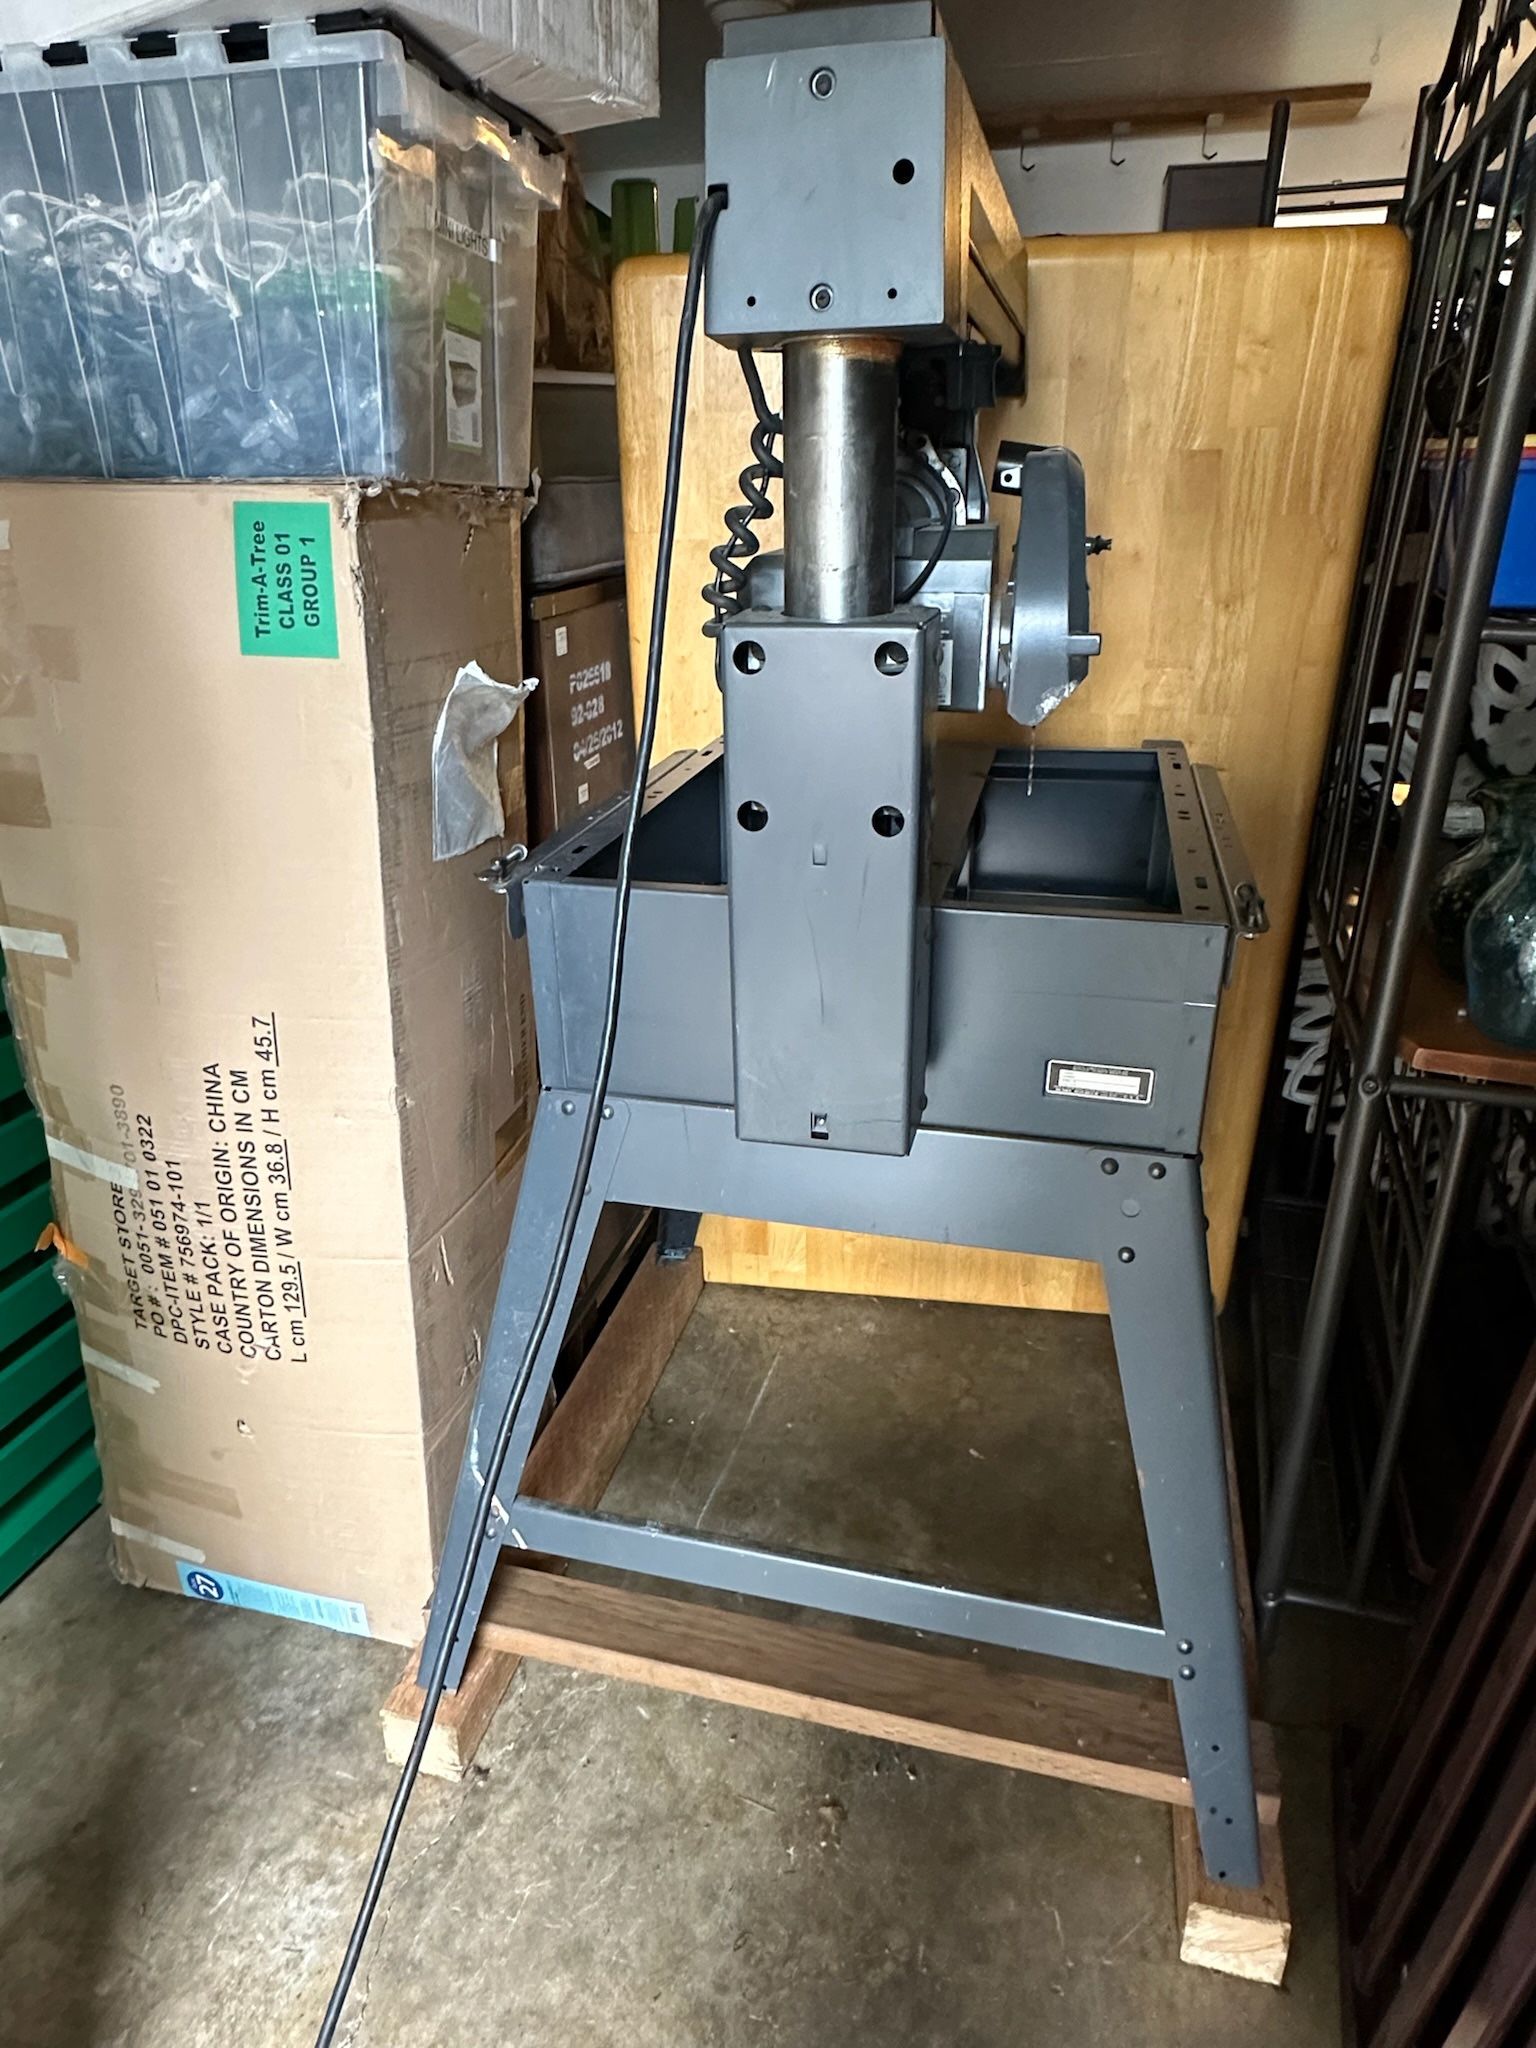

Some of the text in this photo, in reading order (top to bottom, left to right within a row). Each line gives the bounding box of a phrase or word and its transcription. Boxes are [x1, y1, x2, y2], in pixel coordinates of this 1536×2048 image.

[456, 222, 489, 257] LIGHTS
[250, 520, 271, 638] Trim-A-Tree
[274, 533, 295, 629] CLASS 01
[298, 537, 320, 627] GROUP 1
[252, 1016, 273, 1062] 45.7
[261, 1069, 278, 1100] cm
[261, 1109, 280, 1123] H
[262, 1129, 282, 1137] /
[265, 1143, 286, 1185] 36.8
[203, 1063, 256, 1359] COUNTRY OF ORIGIN: CHINA
[229, 1070, 282, 1361] CARTON DIMENSIONS IN CM
[274, 1192, 290, 1221] cm
[137, 1114, 188, 1345] DPC-ITEM # 051 01 0322
[274, 1228, 293, 1246] W
[111, 1181, 148, 1330] TARGET STORE
[165, 1160, 210, 1350] STYLE # 756974-101
[194, 1202, 233, 1354] CASE PACK: 1/1
[279, 1265, 301, 1313] 129.5
[150, 1310, 168, 1339] PO
[290, 1320, 305, 1346] cm
[291, 1353, 307, 1363] L
[195, 1574, 219, 1598] 27
